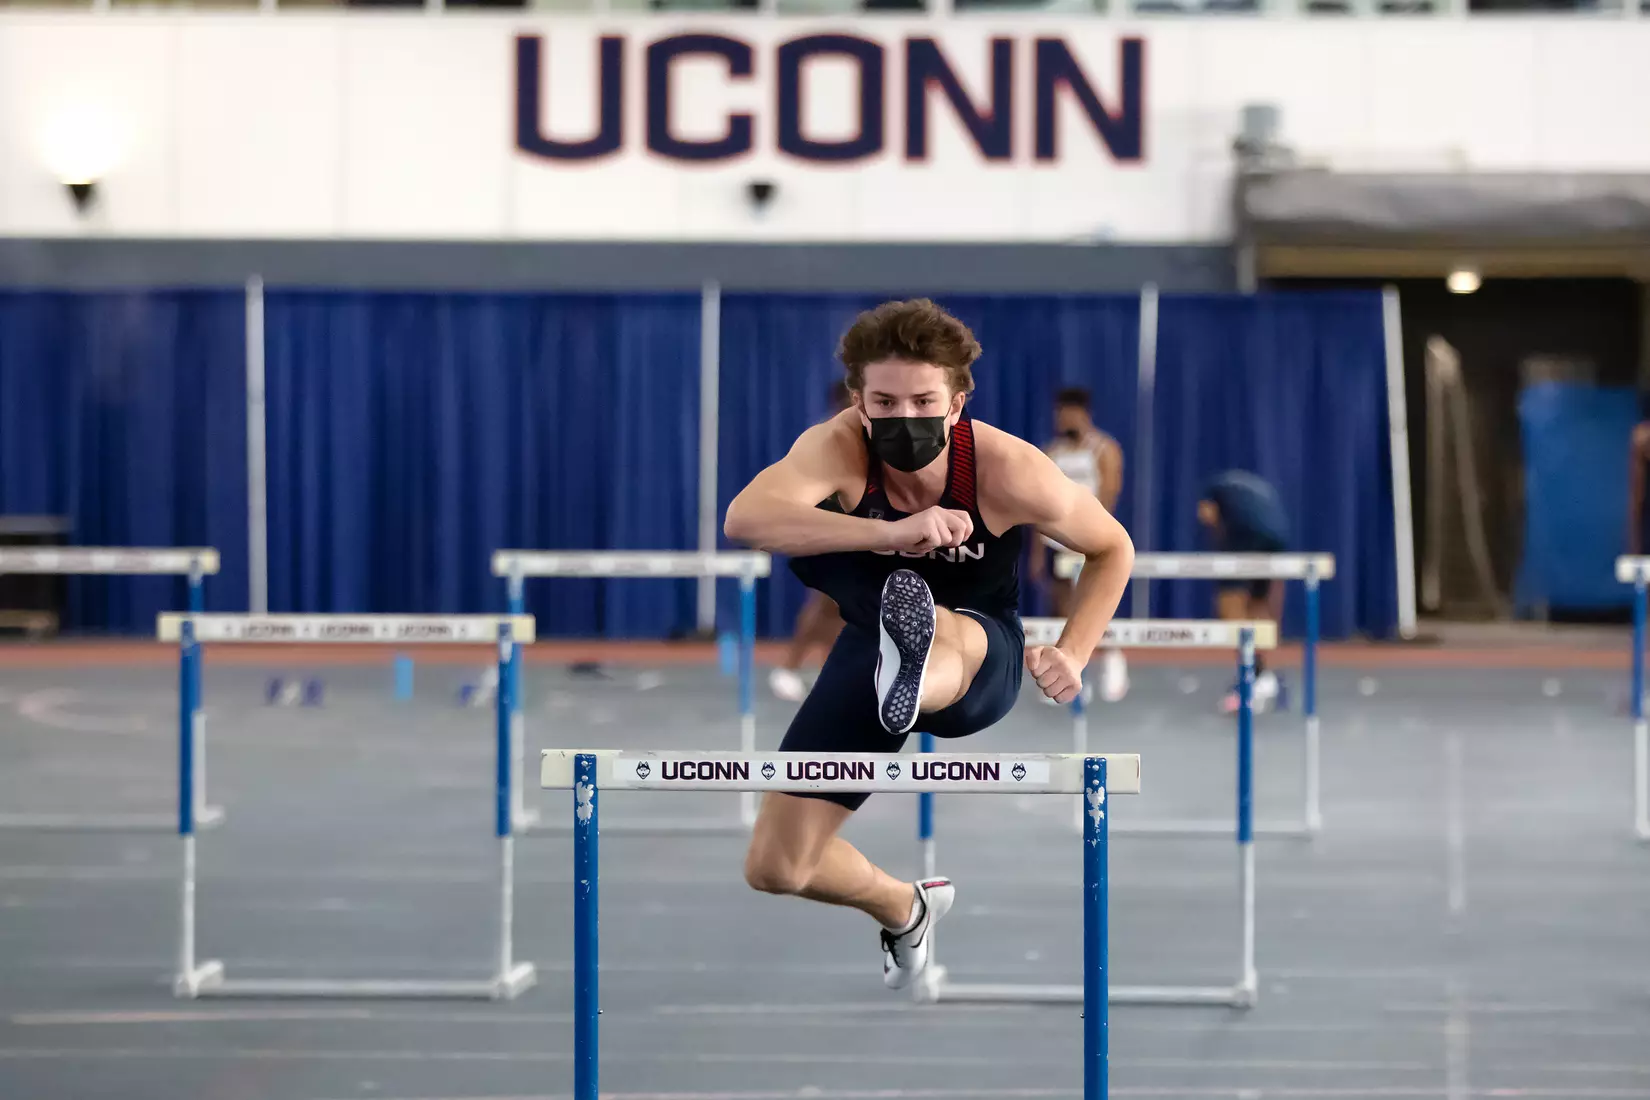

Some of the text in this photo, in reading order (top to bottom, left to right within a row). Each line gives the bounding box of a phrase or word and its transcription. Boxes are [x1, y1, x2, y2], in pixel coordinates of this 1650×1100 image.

[513, 31, 1147, 166] UCONN
[661, 761, 1000, 781] UCONN UCONN UCONN
